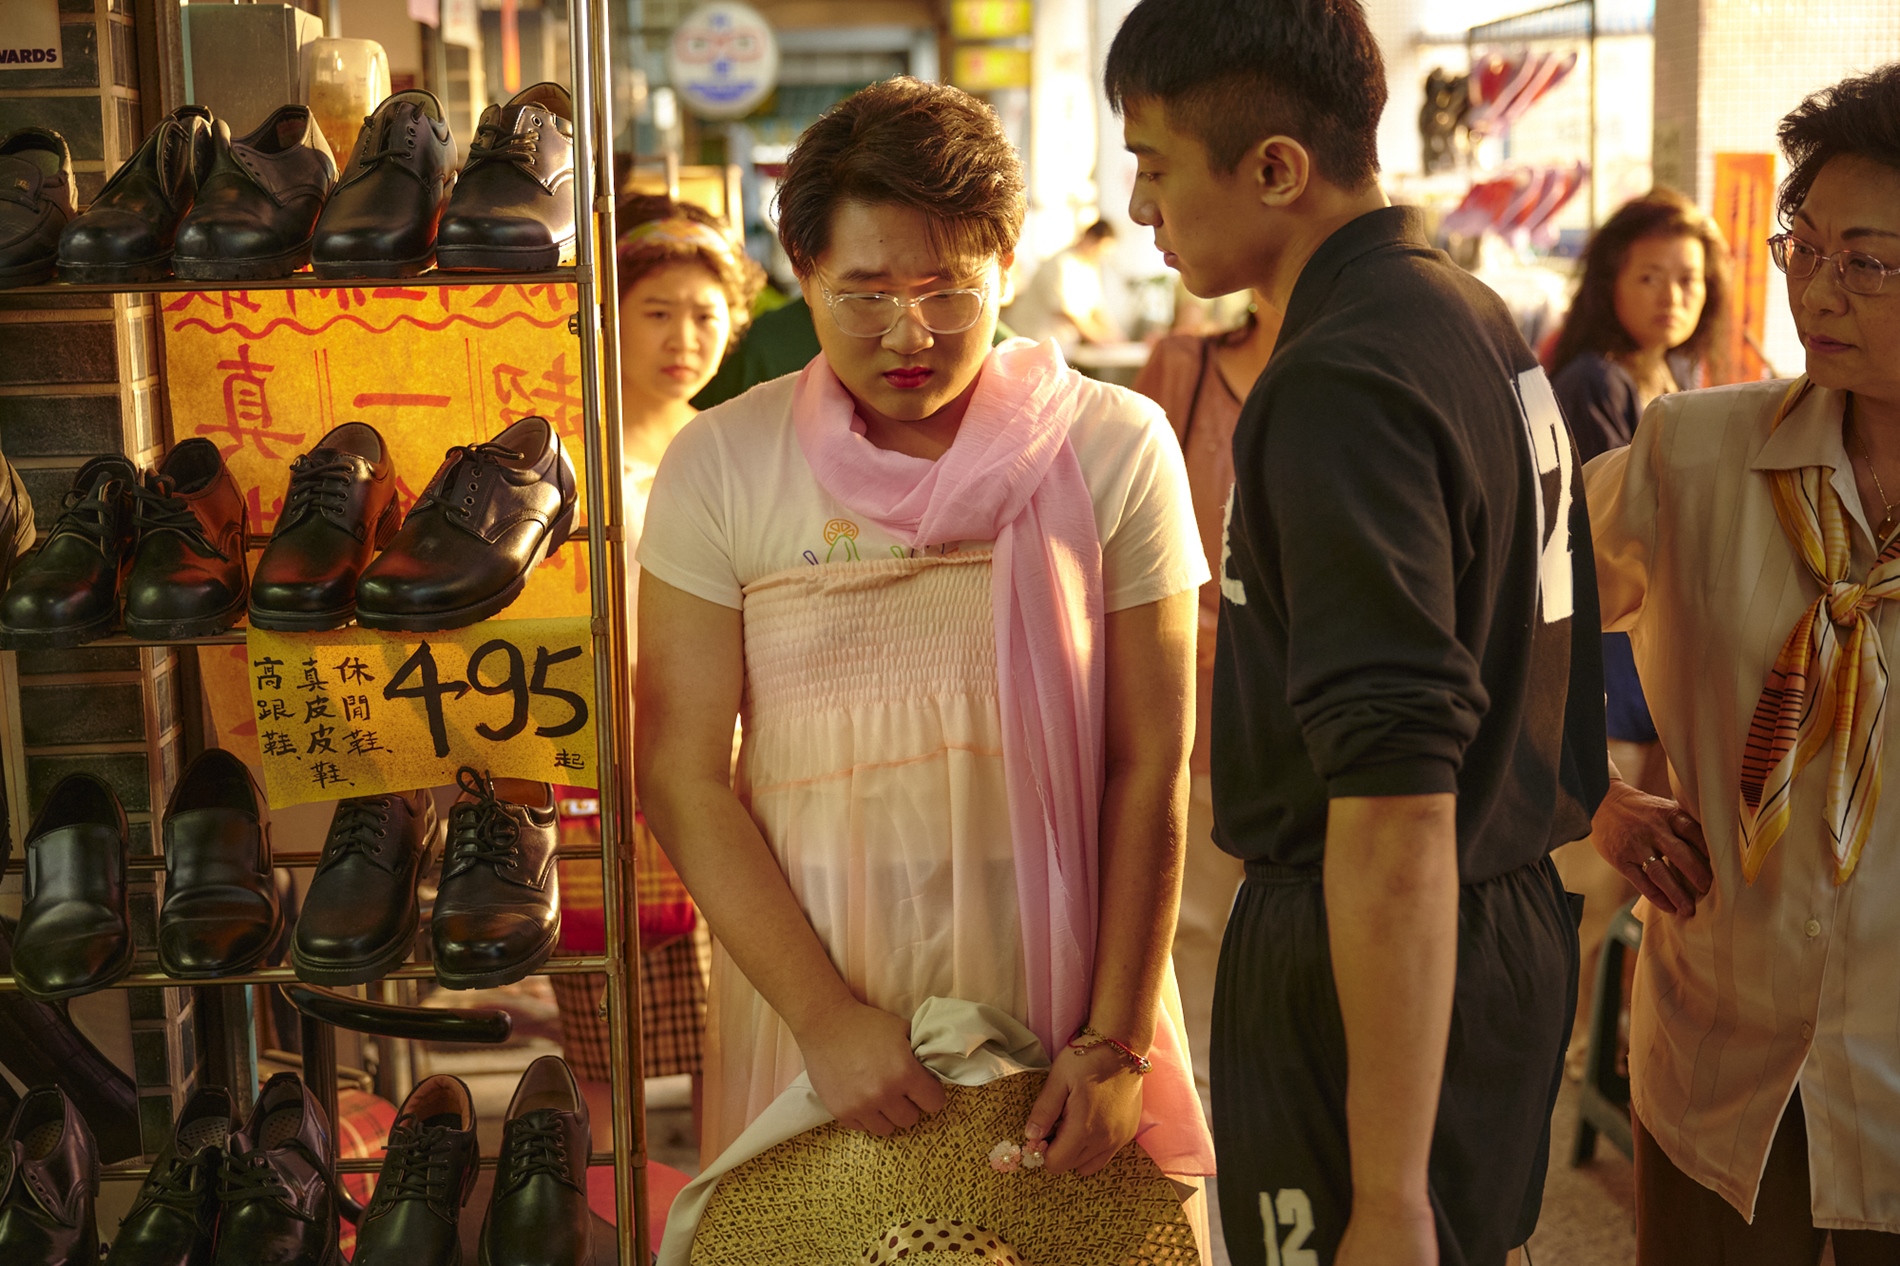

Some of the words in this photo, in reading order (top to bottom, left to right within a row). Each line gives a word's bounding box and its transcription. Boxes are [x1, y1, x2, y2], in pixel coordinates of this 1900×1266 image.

[195, 343, 306, 460] 真
[383, 639, 588, 758] 495
[554, 748, 585, 770] 起
[1259, 1188, 1319, 1266] 12
